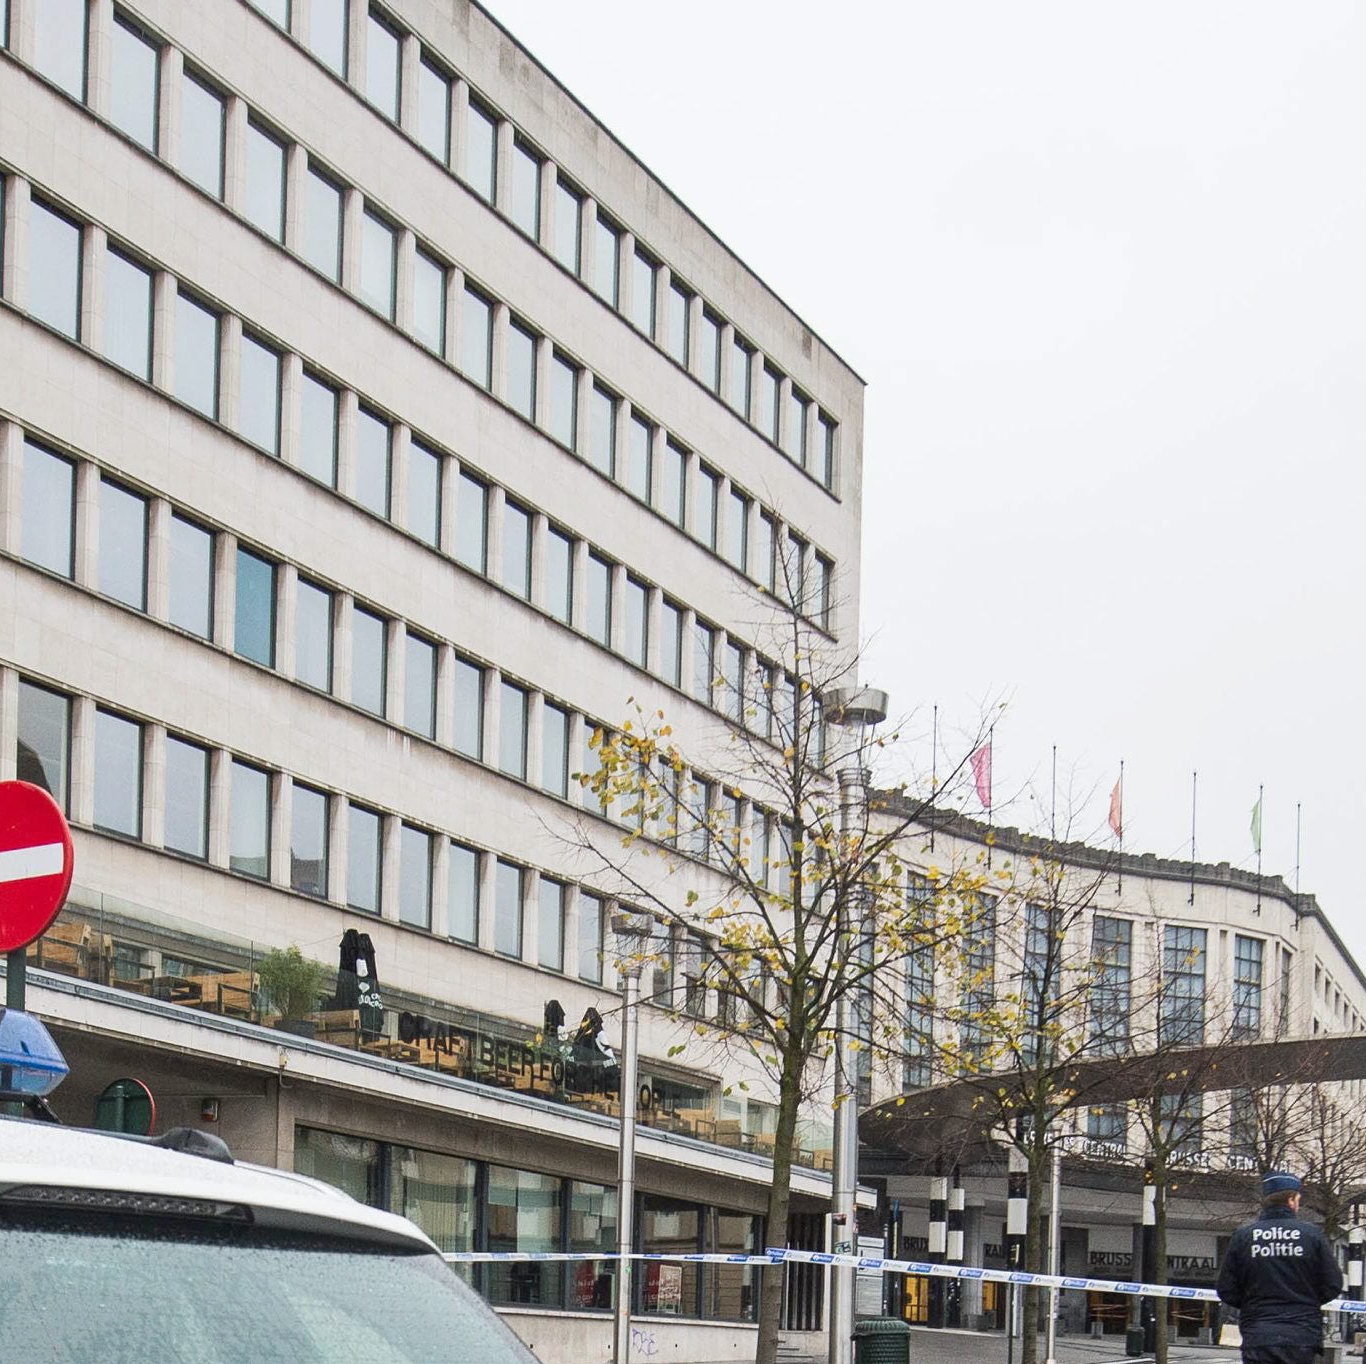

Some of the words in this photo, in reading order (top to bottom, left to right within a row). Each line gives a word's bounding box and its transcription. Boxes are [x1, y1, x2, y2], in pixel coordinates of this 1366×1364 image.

[482, 1037, 534, 1088] BEER
[1252, 1227, 1301, 1241] Police
[1251, 1243, 1304, 1257] Politie
